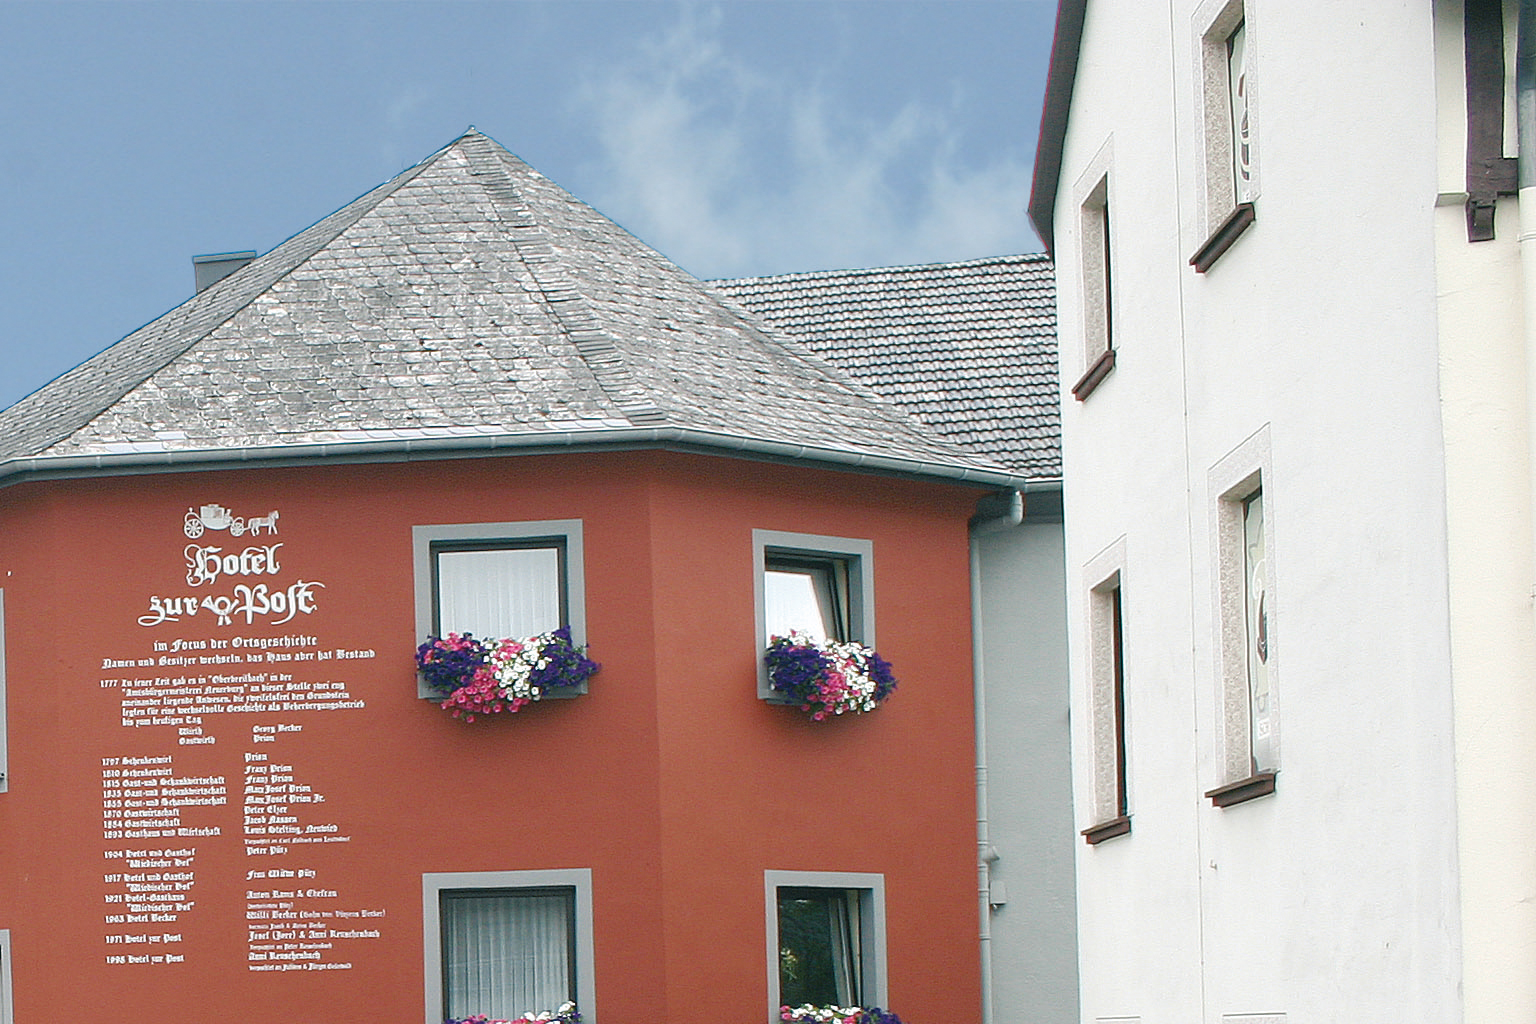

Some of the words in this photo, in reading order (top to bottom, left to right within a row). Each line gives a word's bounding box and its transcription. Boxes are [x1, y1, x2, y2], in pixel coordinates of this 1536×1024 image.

[184, 543, 284, 587] Hotel
[137, 595, 198, 626] zur
[233, 580, 326, 625] Post
[153, 640, 168, 652] im
[210, 638, 228, 649] der
[232, 634, 318, 649] Ortsgeschichte
[101, 658, 135, 670] Namen
[138, 657, 154, 667] und
[247, 653, 263, 662] das
[294, 651, 314, 661] aber
[318, 650, 333, 661] hat
[100, 679, 118, 687] 1777
[296, 890, 304, 898] &
[298, 930, 305, 939] &
